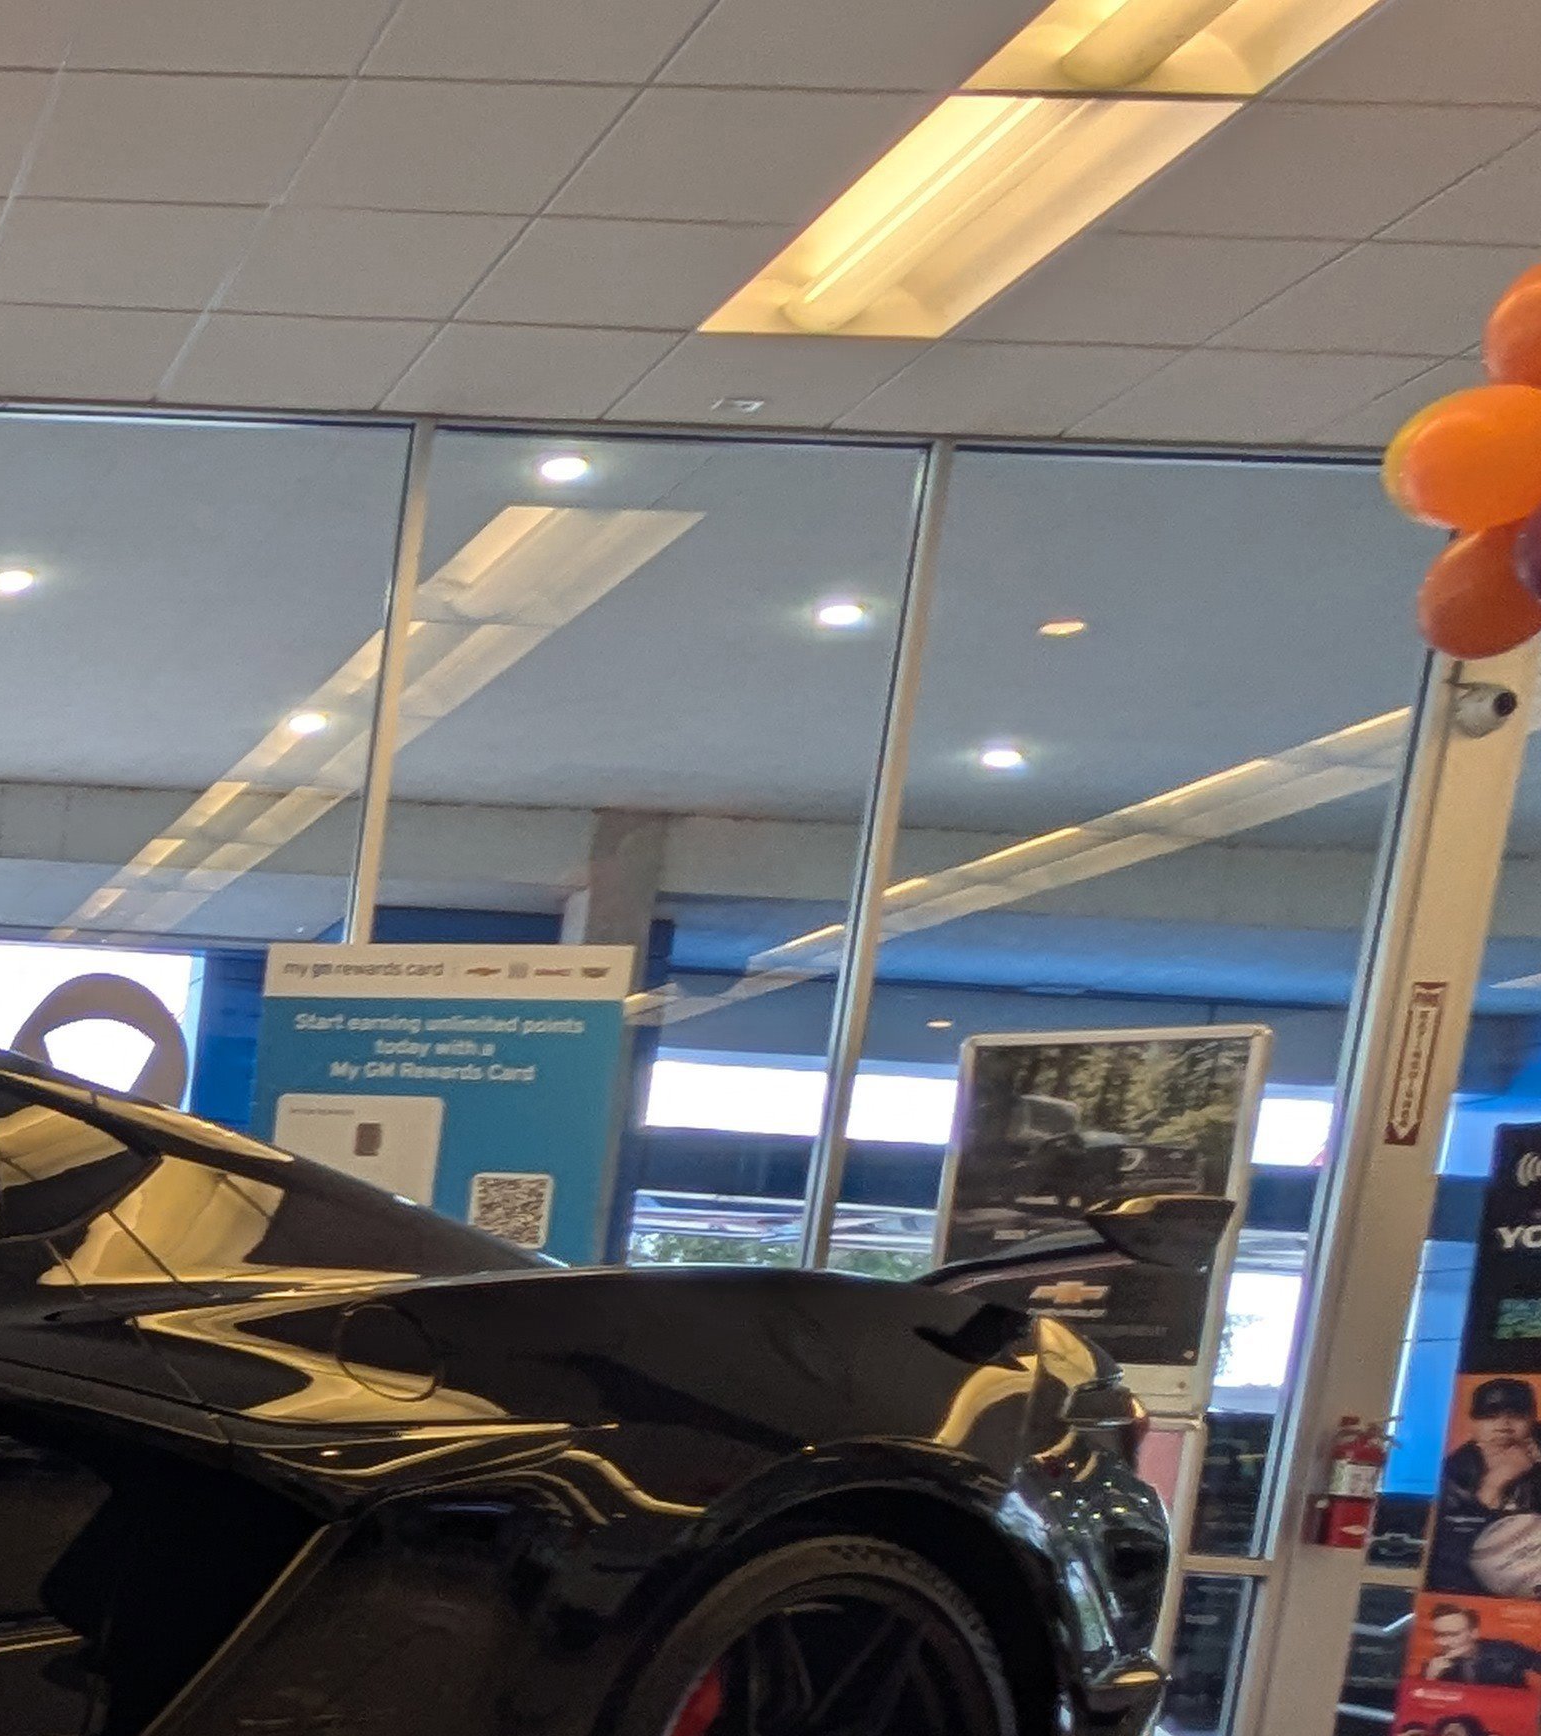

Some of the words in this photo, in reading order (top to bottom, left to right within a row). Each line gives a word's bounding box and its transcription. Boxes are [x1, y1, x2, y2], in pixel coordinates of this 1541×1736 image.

[335, 962, 403, 976] rewards
[405, 962, 444, 976] card
[295, 1013, 344, 1030] Start
[347, 1015, 421, 1033] earning
[425, 1015, 518, 1032] unlimited
[522, 1017, 585, 1035] points
[374, 1039, 430, 1057] today
[434, 1039, 478, 1056] with
[481, 1042, 495, 1056] a
[329, 1062, 360, 1080] My
[363, 1062, 396, 1078] GM
[400, 1063, 484, 1080] Rewards
[487, 1063, 536, 1081] Card
